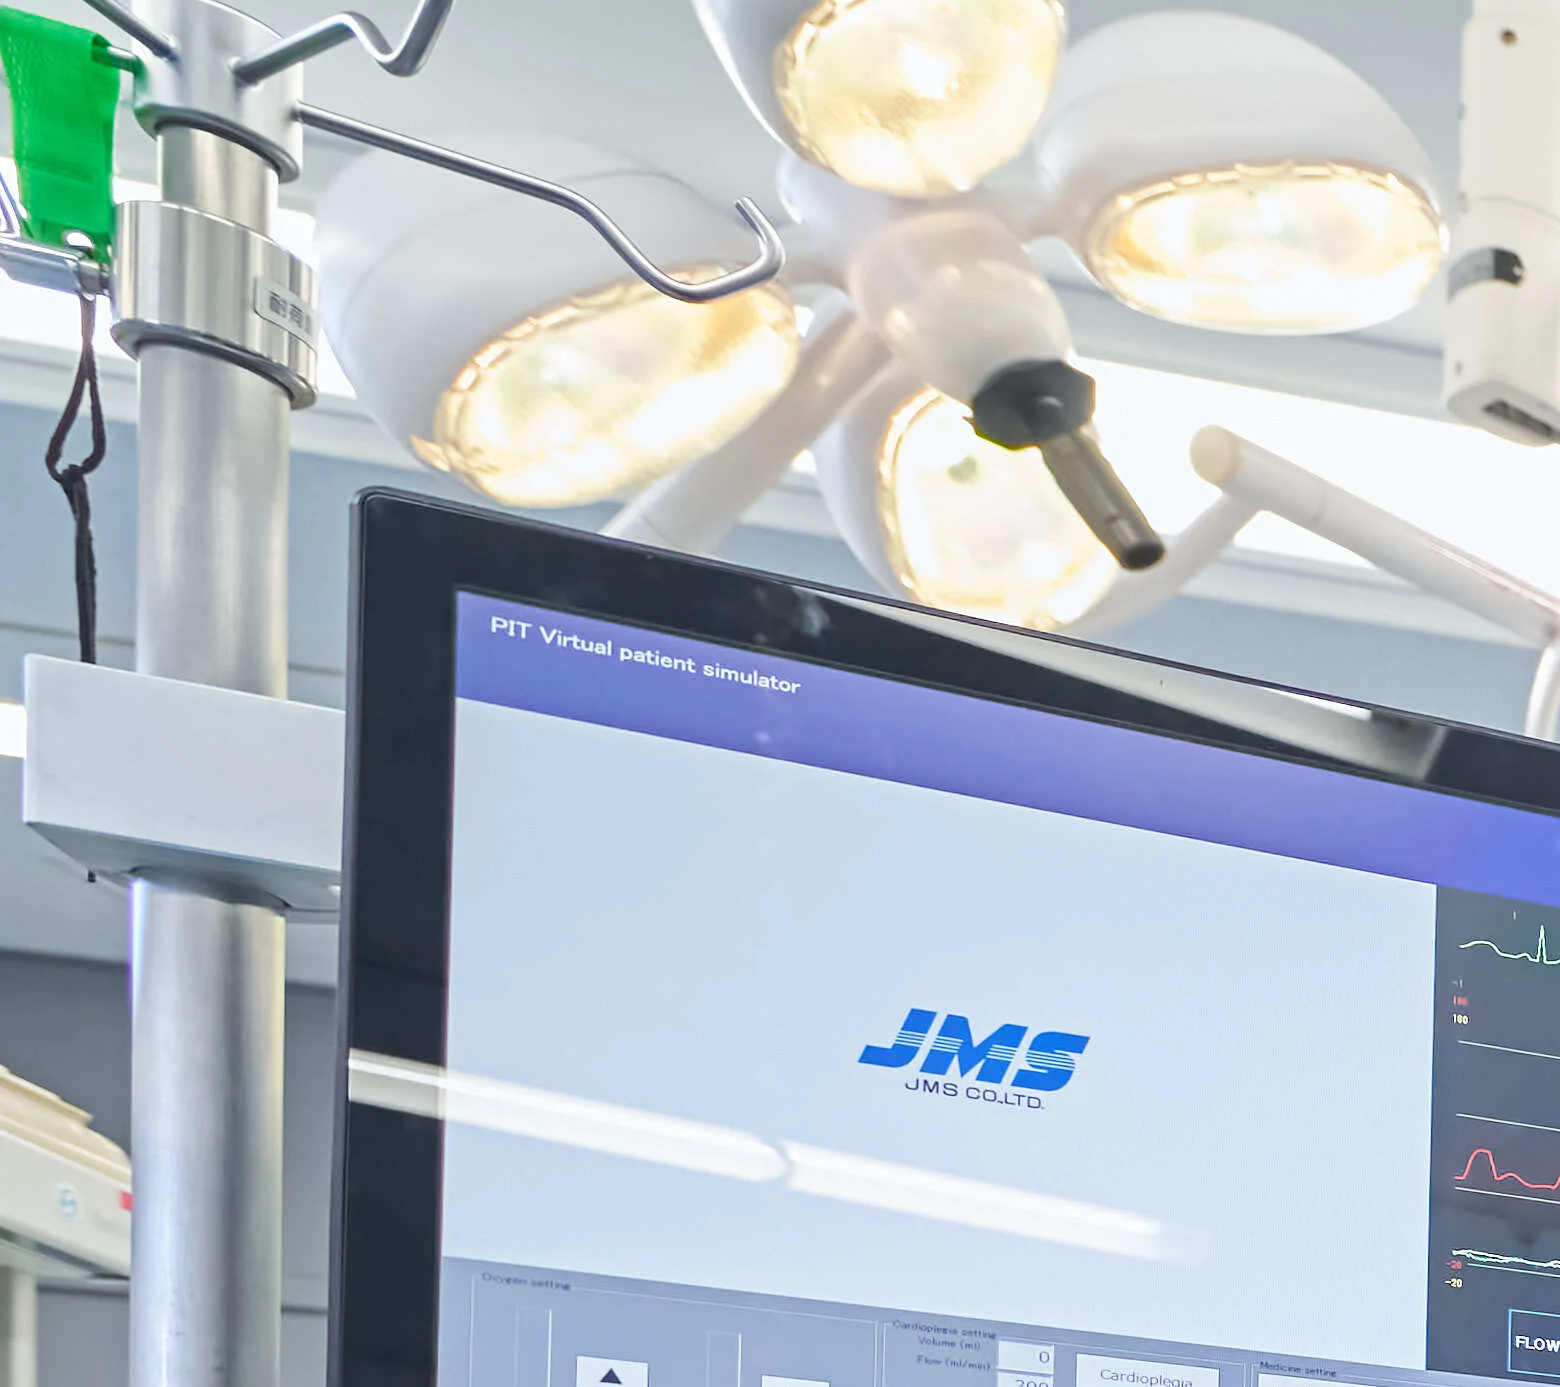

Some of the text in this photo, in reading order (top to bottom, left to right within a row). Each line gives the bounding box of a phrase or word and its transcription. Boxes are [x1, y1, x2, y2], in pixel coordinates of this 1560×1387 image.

[491, 616, 800, 694] PIT Virtual patient simulator
[857, 1008, 1091, 1092] JMS
[905, 1079, 958, 1098] JMS
[1515, 1335, 1560, 1353] FLOW
